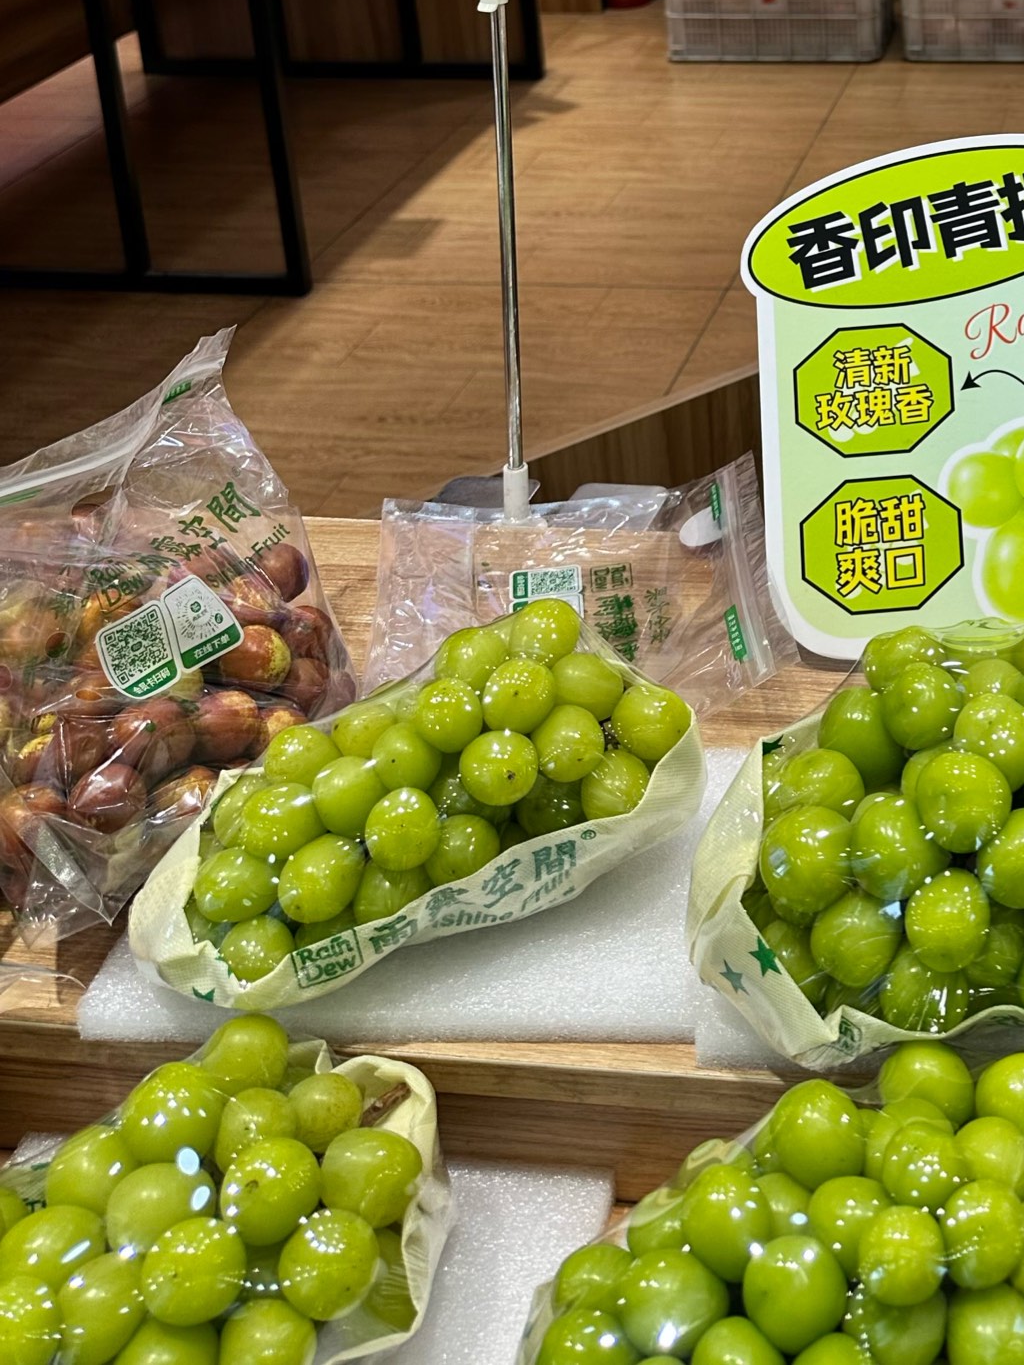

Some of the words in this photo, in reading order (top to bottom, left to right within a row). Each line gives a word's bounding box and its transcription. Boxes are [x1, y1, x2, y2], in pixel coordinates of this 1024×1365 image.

[832, 347, 912, 389] 清新
[815, 385, 932, 432] 玫瑰香
[834, 493, 927, 545] 脆甜
[251, 522, 291, 556] Fruit
[836, 548, 927, 596] 爽口
[193, 633, 231, 659] 在线下单
[133, 667, 171, 694] 会员卡扫码
[431, 909, 514, 929] shine
[296, 935, 353, 965] Rain
[300, 953, 358, 983] Dew
